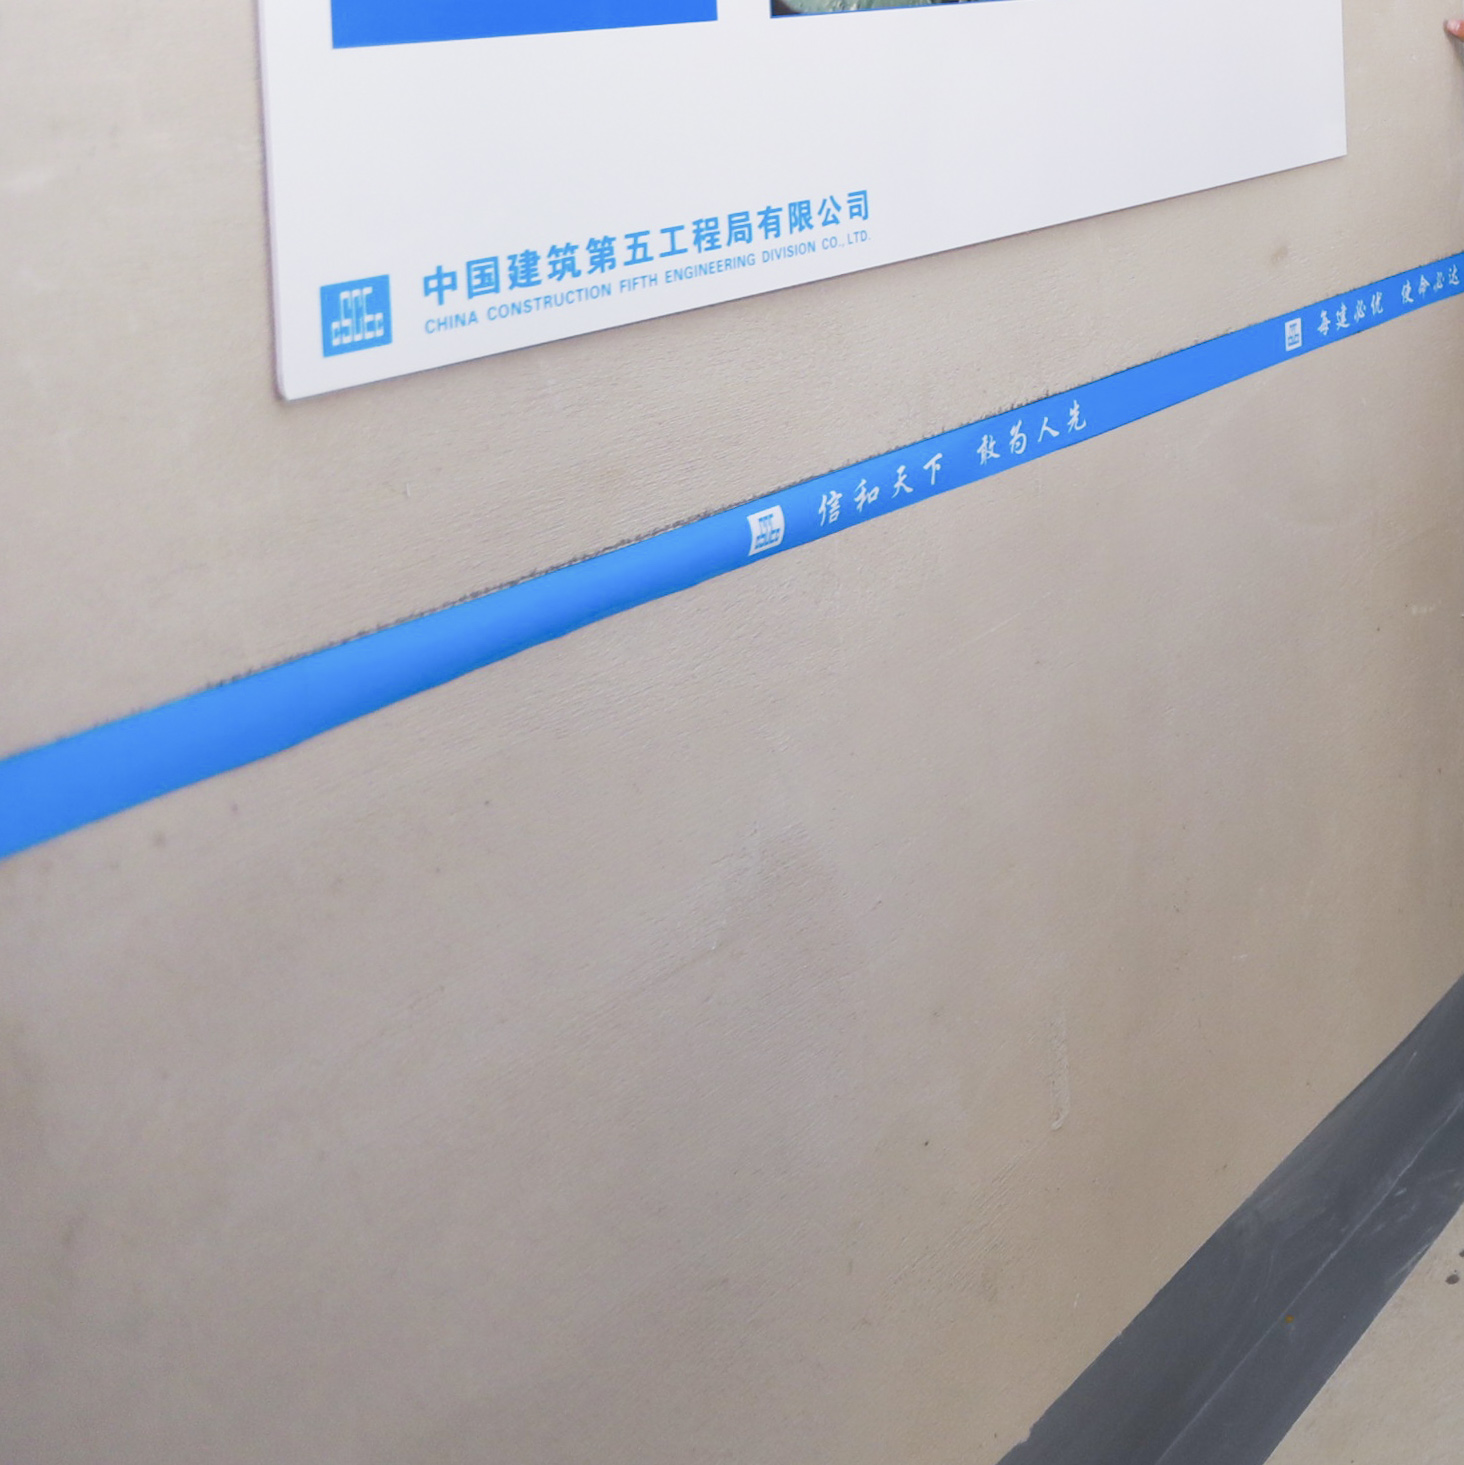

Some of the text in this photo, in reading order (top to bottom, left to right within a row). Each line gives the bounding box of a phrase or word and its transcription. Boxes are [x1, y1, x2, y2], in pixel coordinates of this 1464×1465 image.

[422, 189, 871, 306] 中国建筑第五工程局有限公司
[424, 311, 480, 335] CHINA
[486, 283, 612, 321] CONSTRUCTION
[619, 273, 659, 301] FIFTH
[665, 253, 756, 284] ENGINEERING
[761, 242, 817, 266] DIVISION
[818, 399, 1087, 527] 信和天下 敢为人先
